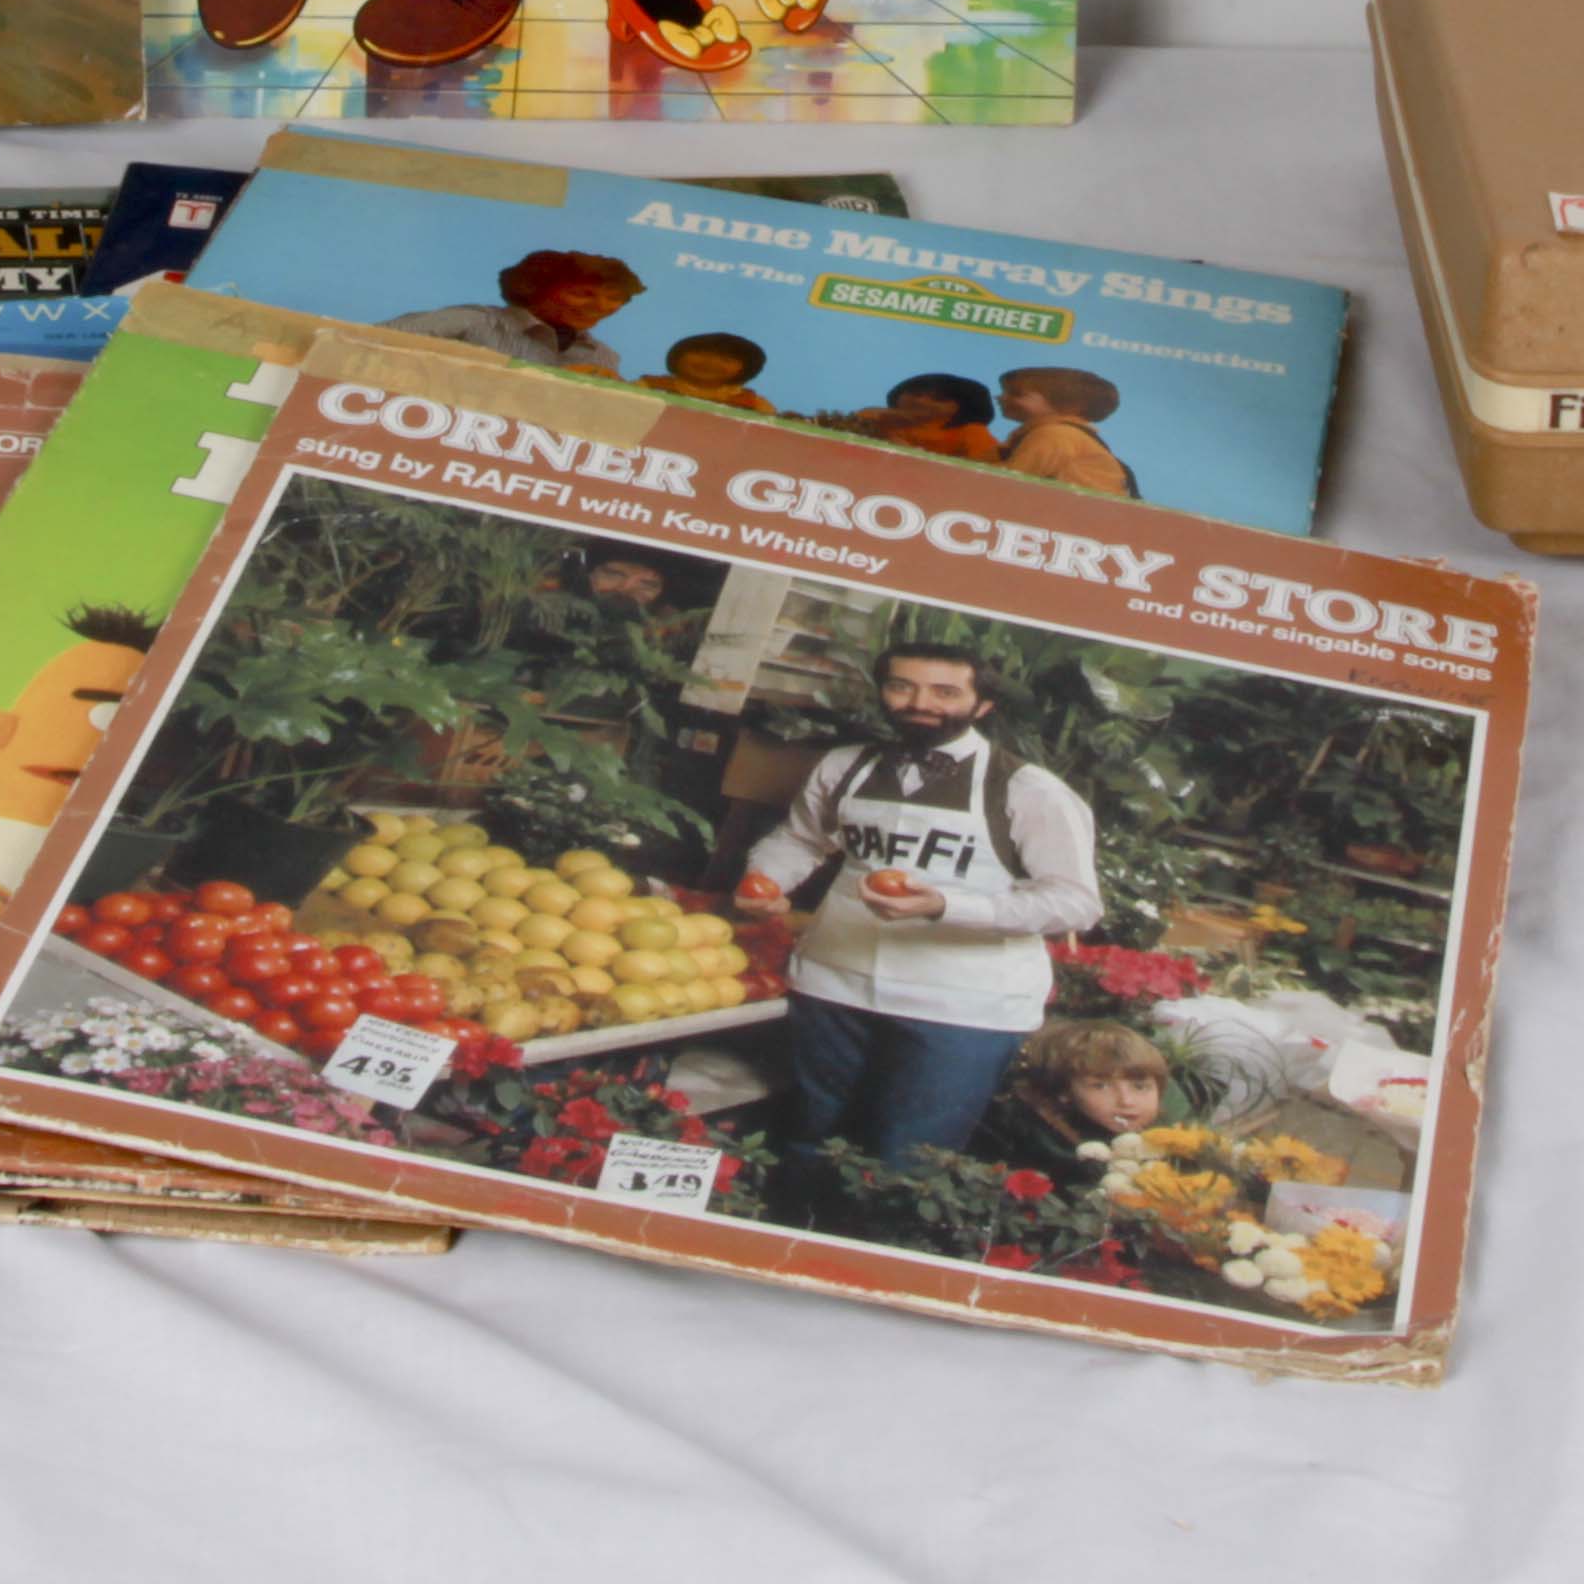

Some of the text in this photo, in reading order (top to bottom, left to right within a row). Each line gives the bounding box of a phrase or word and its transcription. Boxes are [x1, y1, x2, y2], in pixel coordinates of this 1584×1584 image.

[626, 201, 1293, 325] Anne Murray Sings
[675, 252, 807, 287] For The
[830, 282, 1056, 336] SESAME STREET
[1081, 330, 1288, 376] Generation
[295, 436, 383, 472] sung
[389, 452, 436, 481] by
[441, 461, 575, 508] RAFFI
[579, 493, 653, 525] with
[661, 509, 732, 541] Ken
[739, 526, 890, 575] Whiteley
[317, 382, 700, 499] CORNER
[725, 468, 1175, 594] GROCERY
[1192, 564, 1500, 664] STORE
[1127, 596, 1493, 684] and other singable songs
